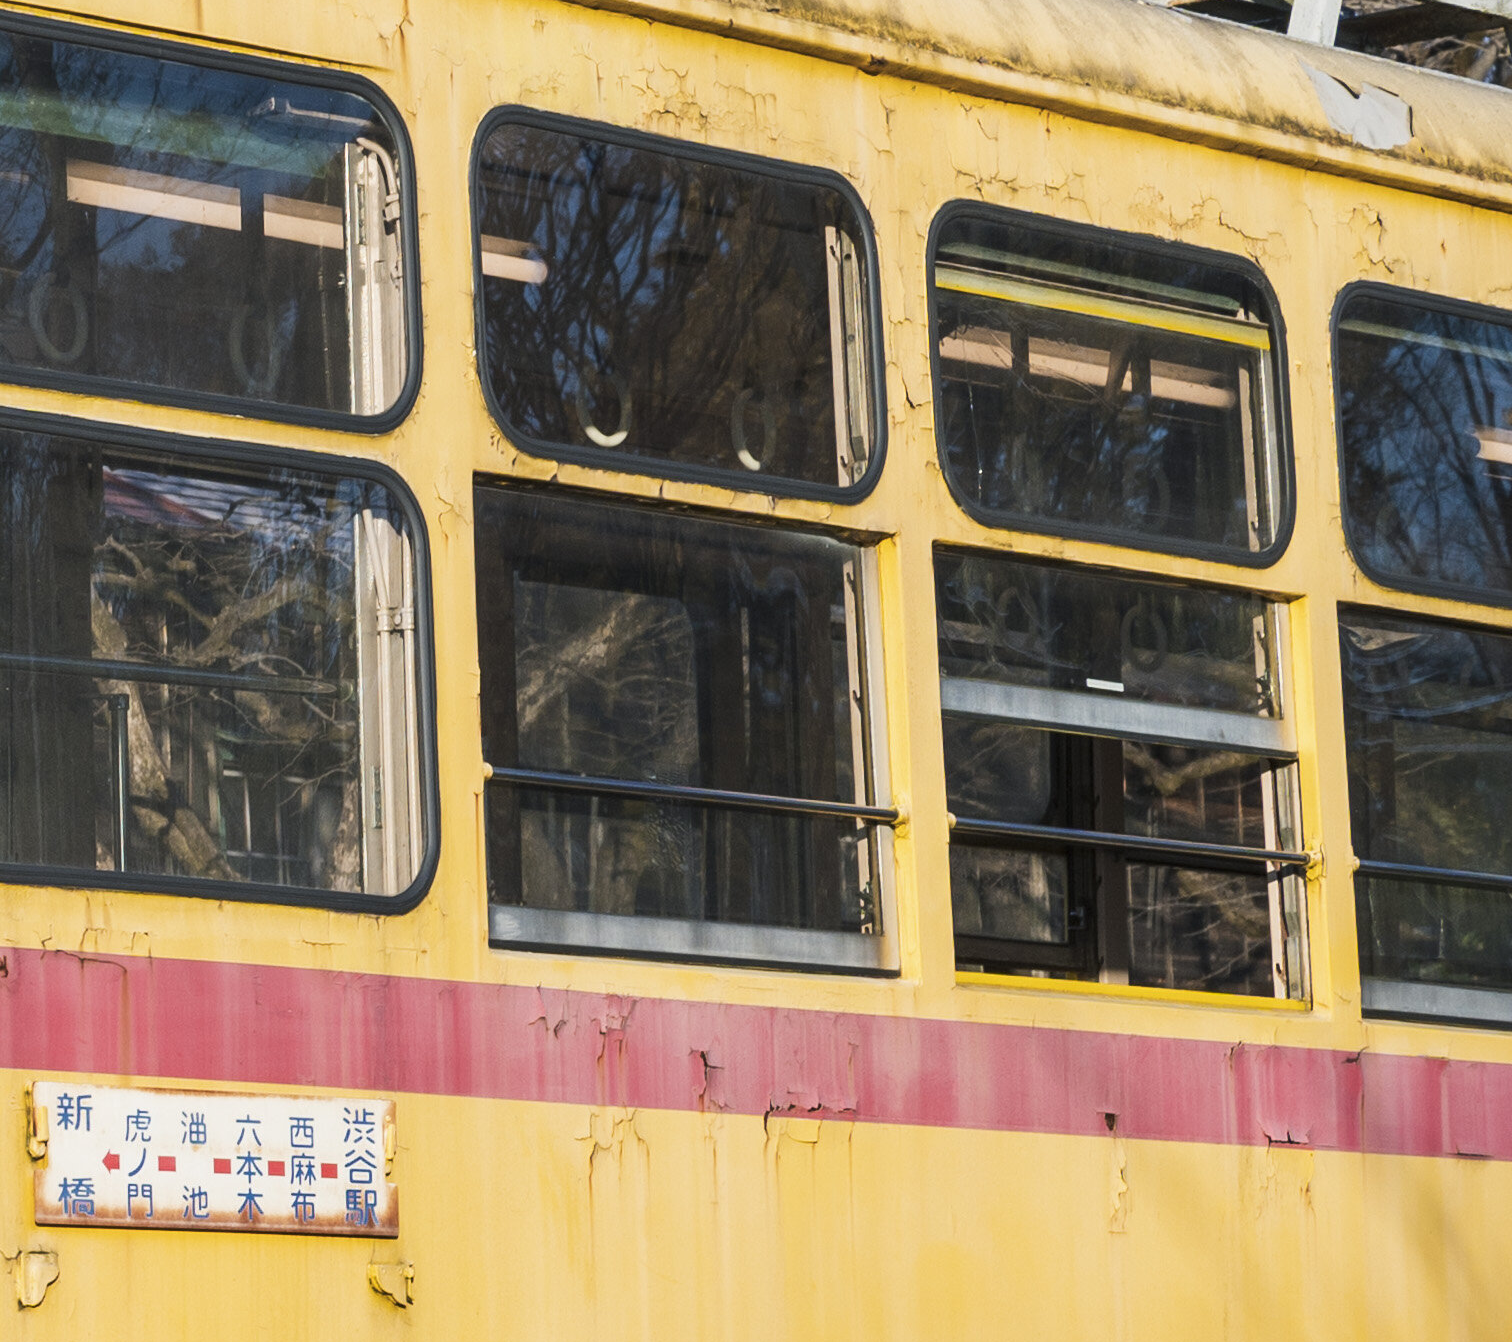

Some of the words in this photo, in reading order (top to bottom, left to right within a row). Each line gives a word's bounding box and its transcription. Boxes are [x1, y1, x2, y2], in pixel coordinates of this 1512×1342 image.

[57, 1093, 95, 1216] 新橋
[125, 1109, 153, 1218] 虎ノ門
[236, 1114, 264, 1221] 六本木
[289, 1117, 316, 1222] 西麻布
[343, 1107, 380, 1226] 渋谷駅
